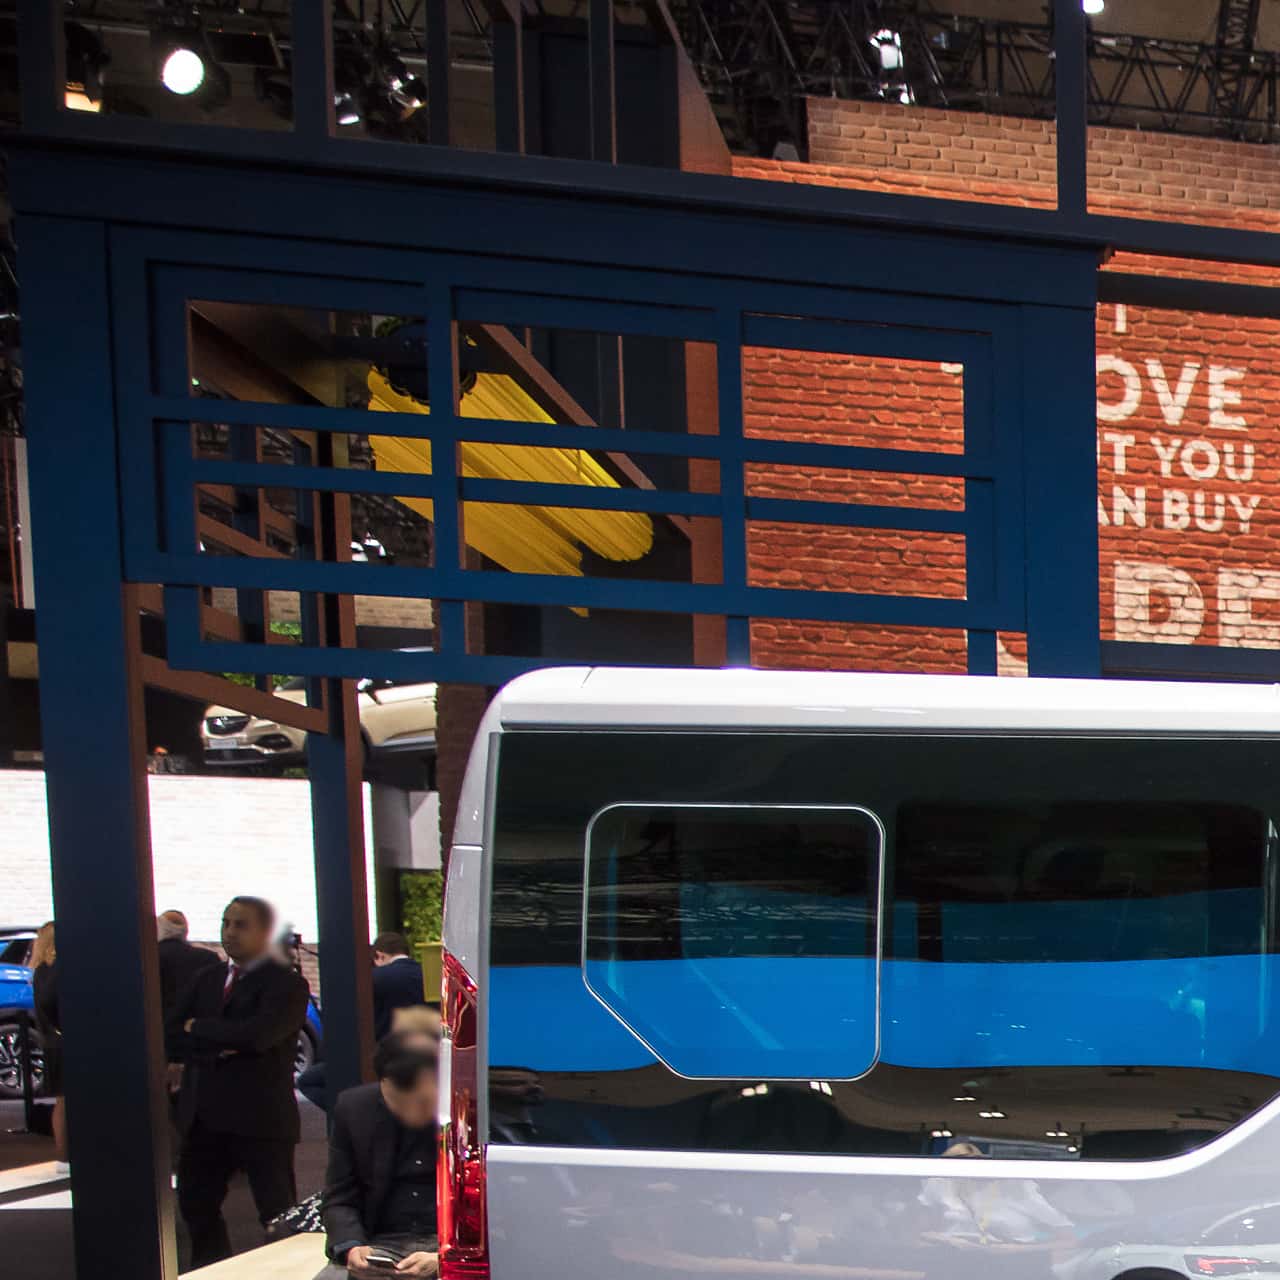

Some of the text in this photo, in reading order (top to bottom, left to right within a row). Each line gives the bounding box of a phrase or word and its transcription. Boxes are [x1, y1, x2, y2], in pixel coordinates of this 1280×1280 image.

[1096, 354, 1248, 431] OVE
[1150, 436, 1255, 482] YOU
[1162, 488, 1261, 534] BUY
